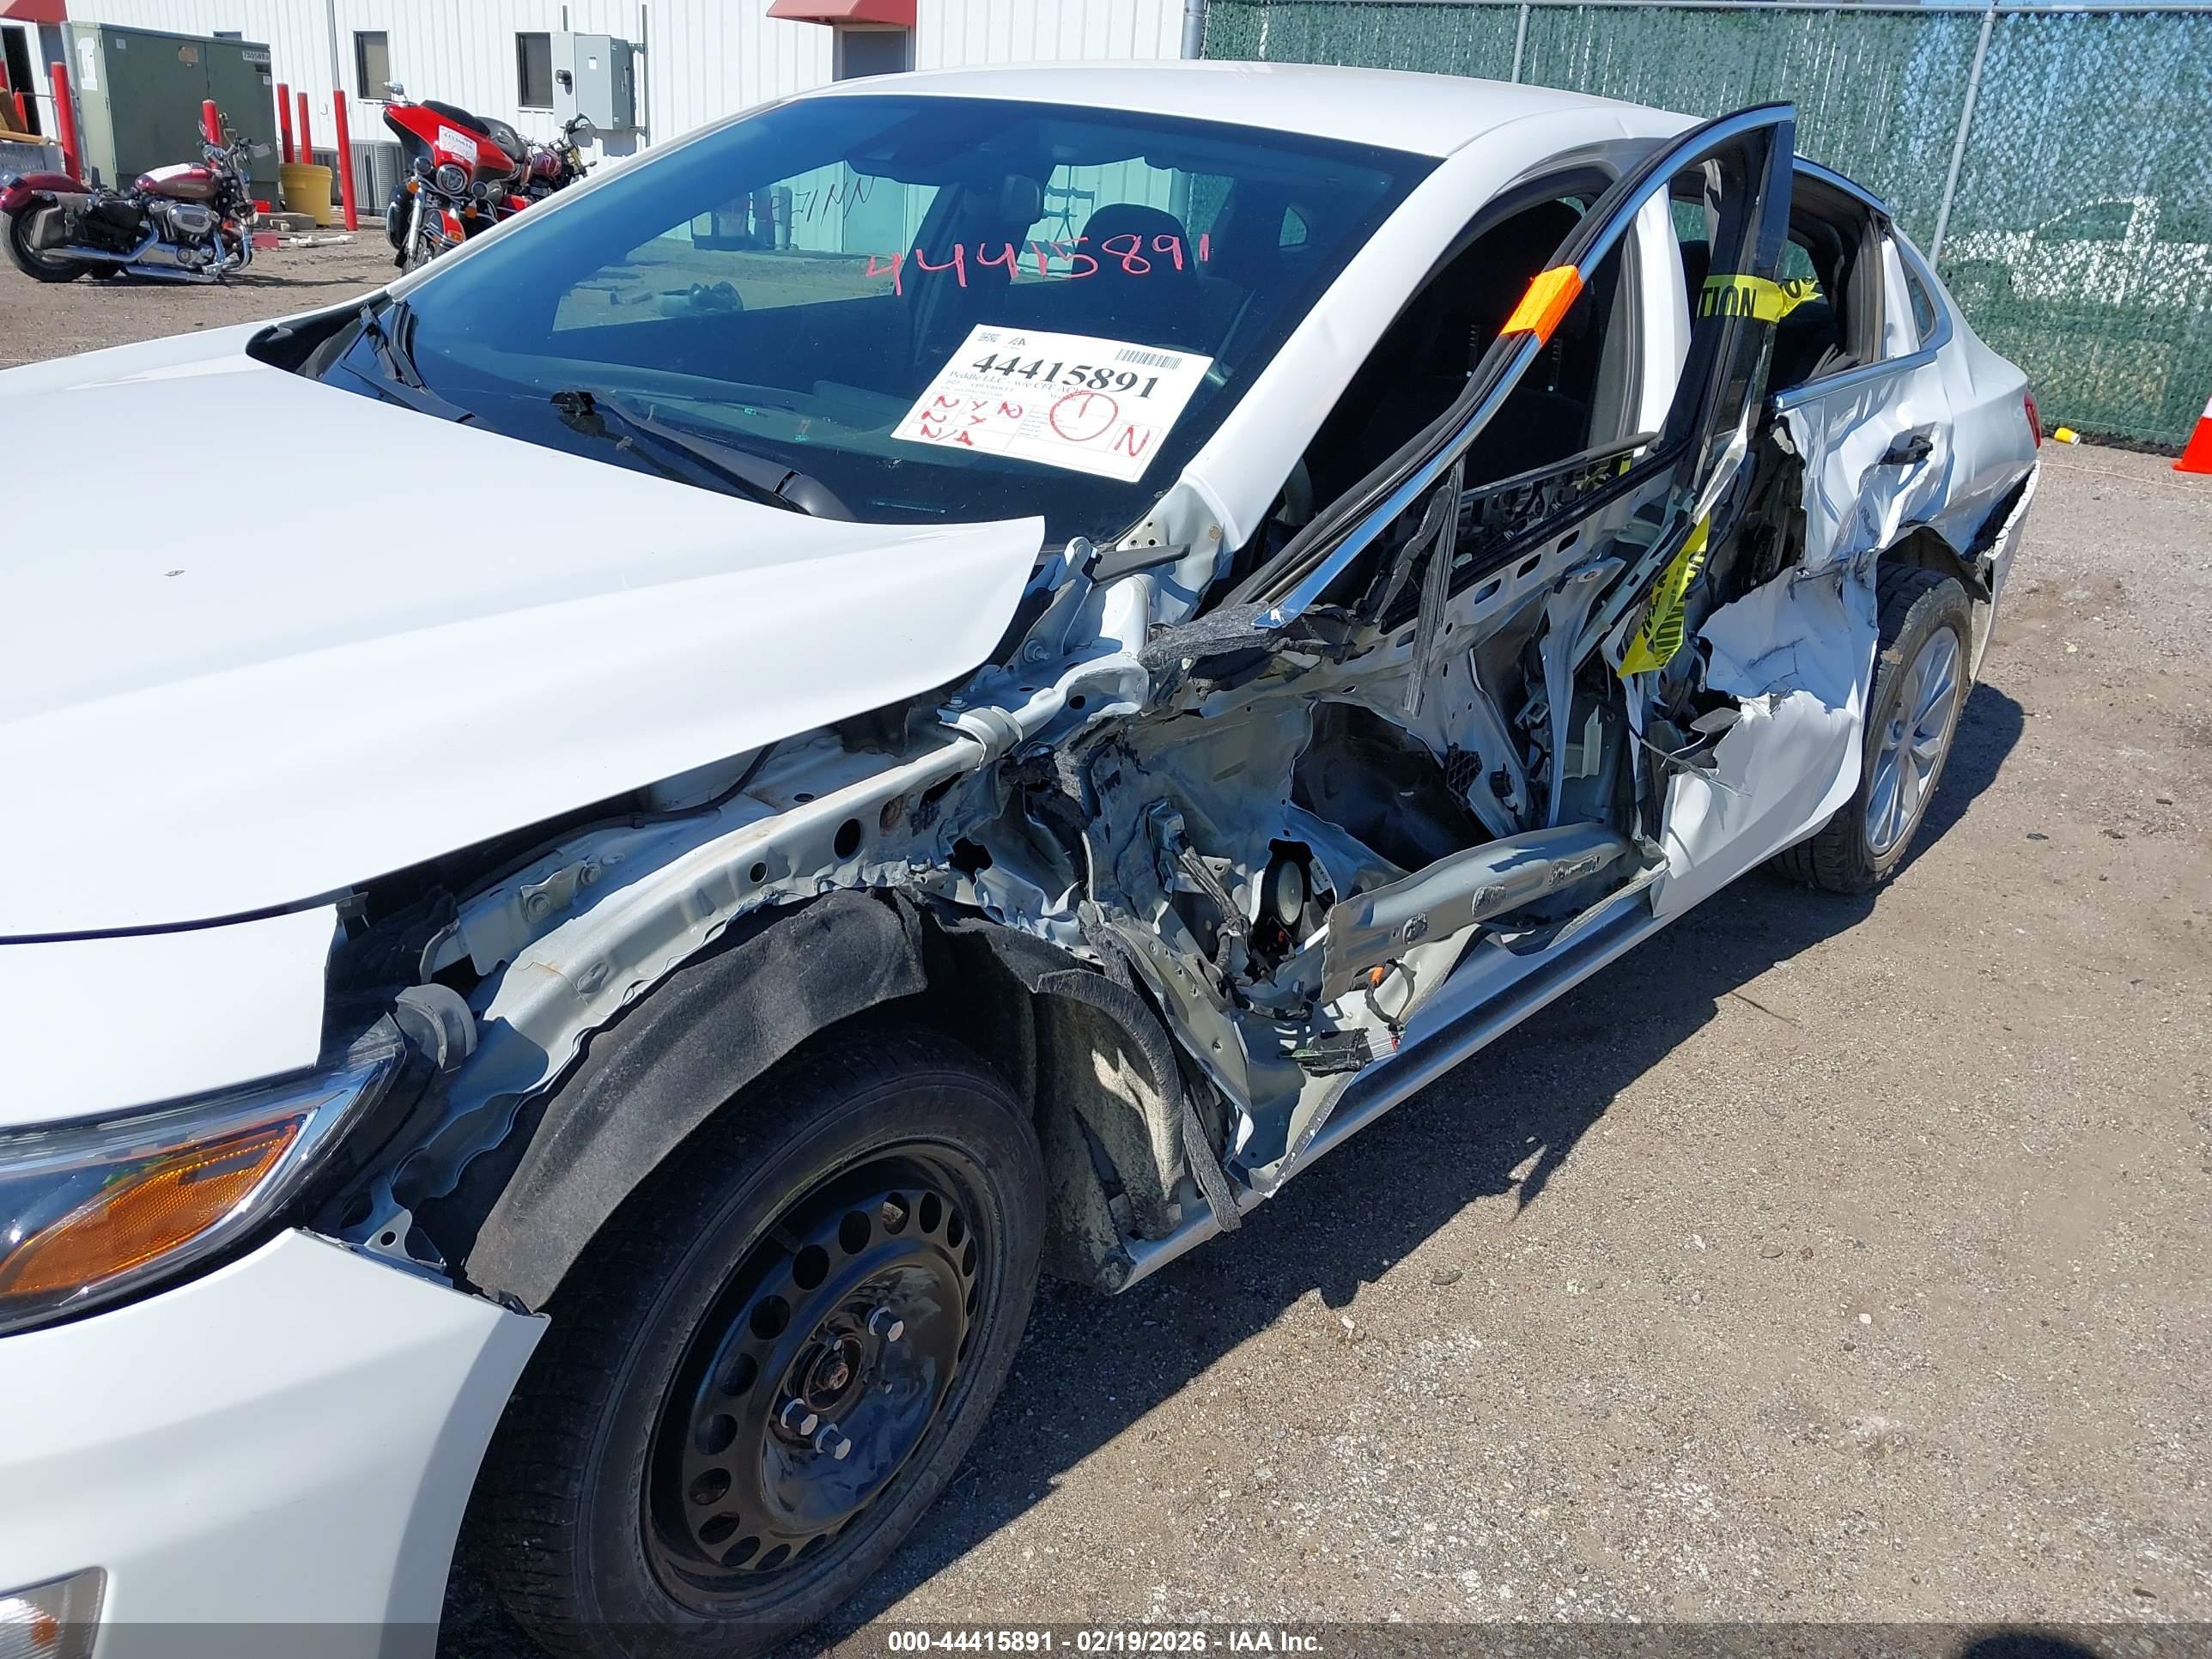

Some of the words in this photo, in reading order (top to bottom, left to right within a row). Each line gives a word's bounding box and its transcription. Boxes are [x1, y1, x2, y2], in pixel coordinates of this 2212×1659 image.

[866, 234, 1210, 296] 44415891
[949, 370, 981, 381] Peddle
[982, 374, 1005, 384] LLC
[972, 353, 1161, 399] 44415891
[1114, 424, 1151, 458] N
